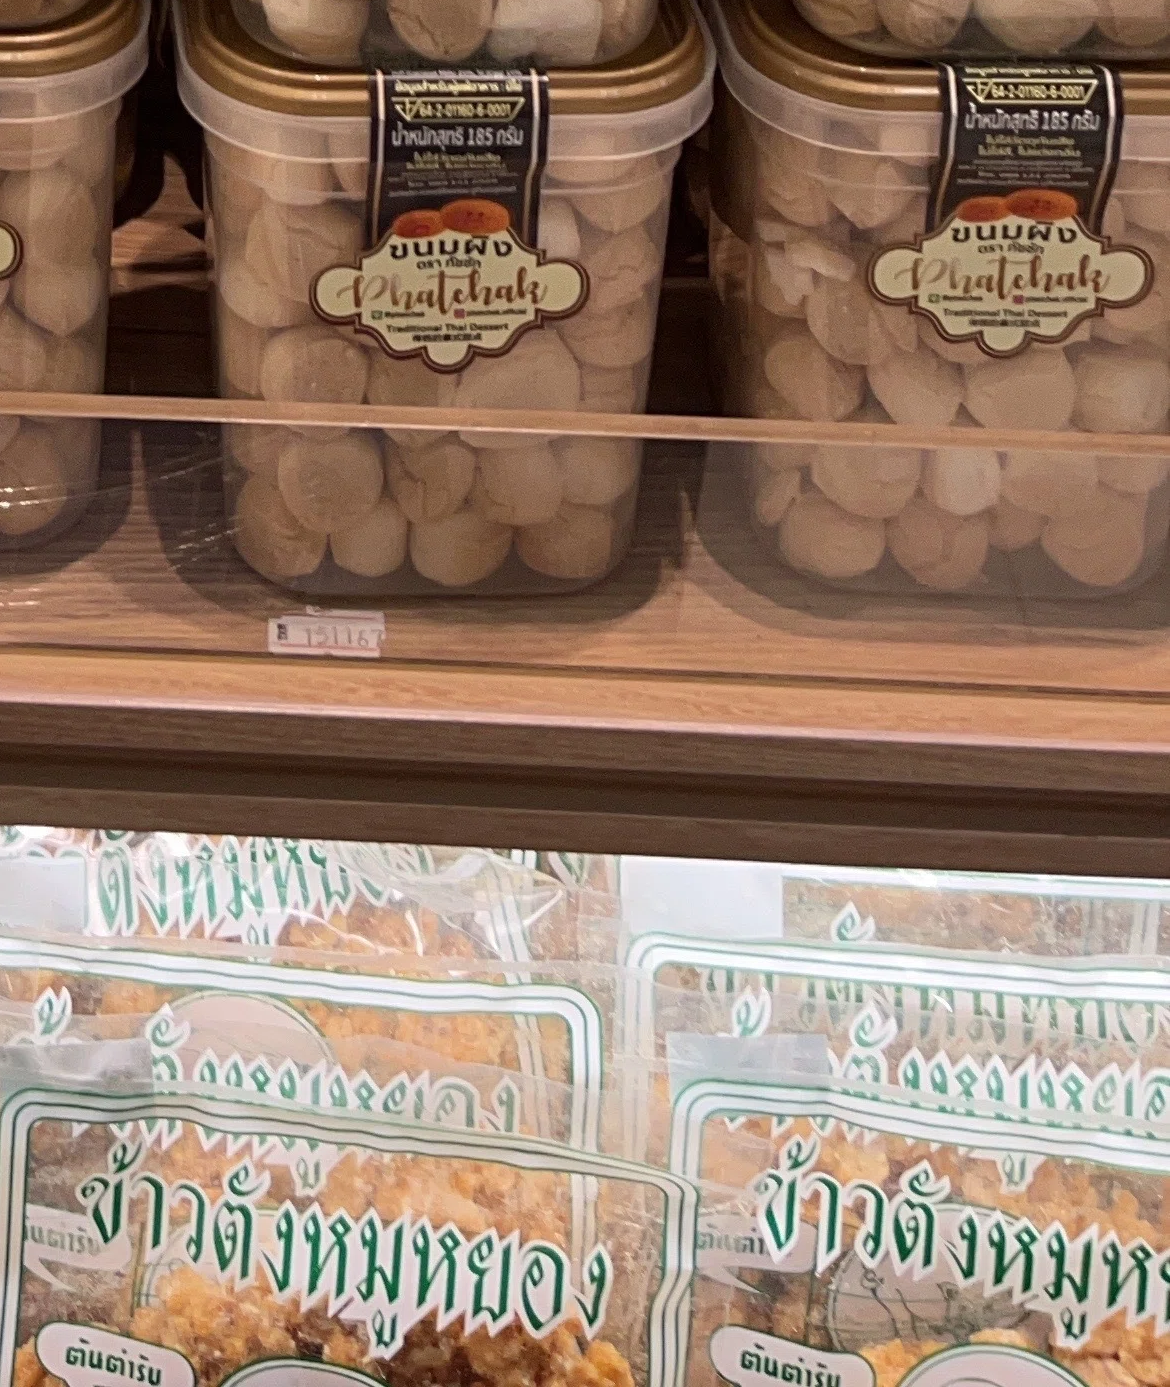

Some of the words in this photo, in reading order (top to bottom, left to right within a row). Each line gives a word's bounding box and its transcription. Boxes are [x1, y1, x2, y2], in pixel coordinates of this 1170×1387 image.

[1042, 111, 1069, 130] 185
[467, 128, 493, 146] 185
[951, 221, 1076, 243] ขนมผิง
[390, 236, 512, 260] ขนมผิง
[894, 255, 1109, 299] Phatchak
[337, 266, 547, 315] Phatchak
[944, 309, 1000, 317] Traditional
[387, 324, 442, 333] Traditional
[446, 323, 468, 331] Thai
[80, 1142, 608, 1348] ข้าวตังหมูหยอง
